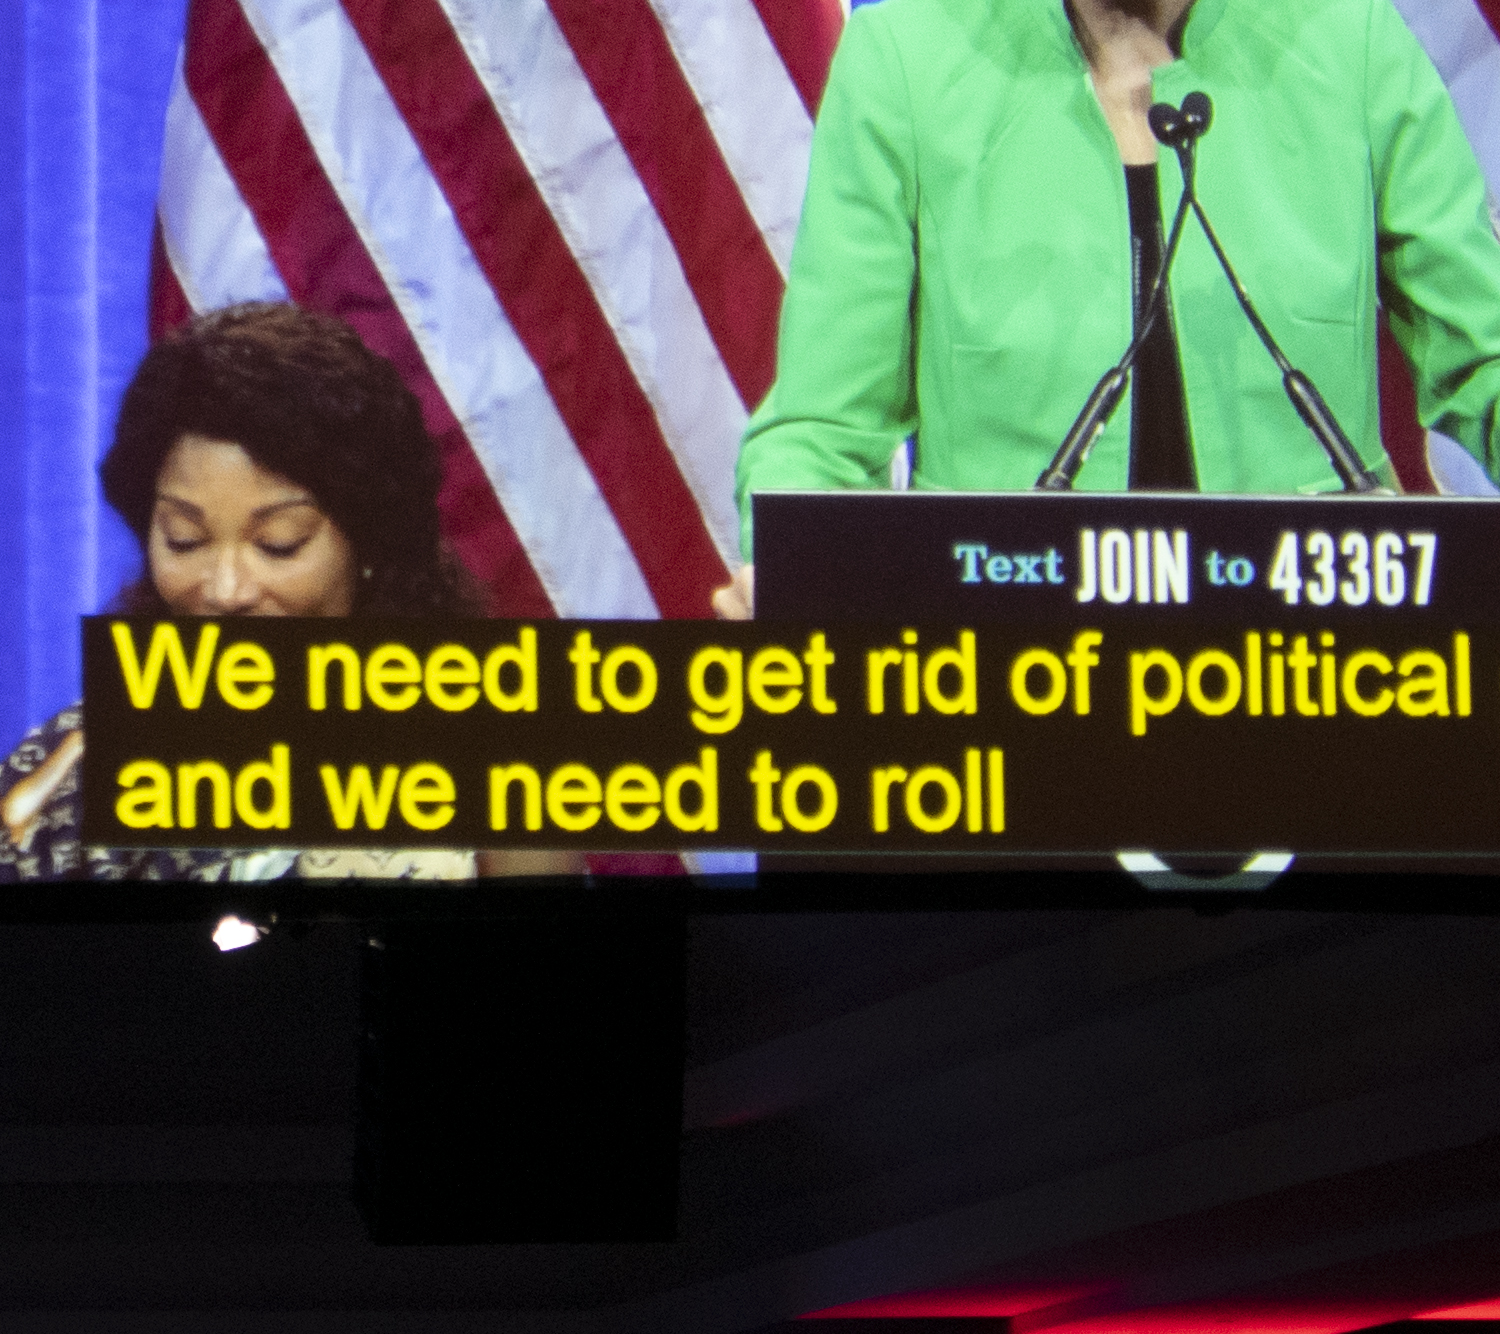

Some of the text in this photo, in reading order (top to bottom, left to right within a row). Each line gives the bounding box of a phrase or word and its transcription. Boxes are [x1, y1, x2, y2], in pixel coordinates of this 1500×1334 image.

[954, 529, 1439, 607] Text JOIN to 43367
[111, 624, 277, 711] We
[307, 626, 540, 714] need
[568, 634, 659, 715] to
[687, 635, 838, 736] get
[866, 630, 979, 717] rid
[1009, 630, 1104, 717] of
[1128, 632, 1473, 737] political
[115, 742, 1006, 835] and we need to roll
